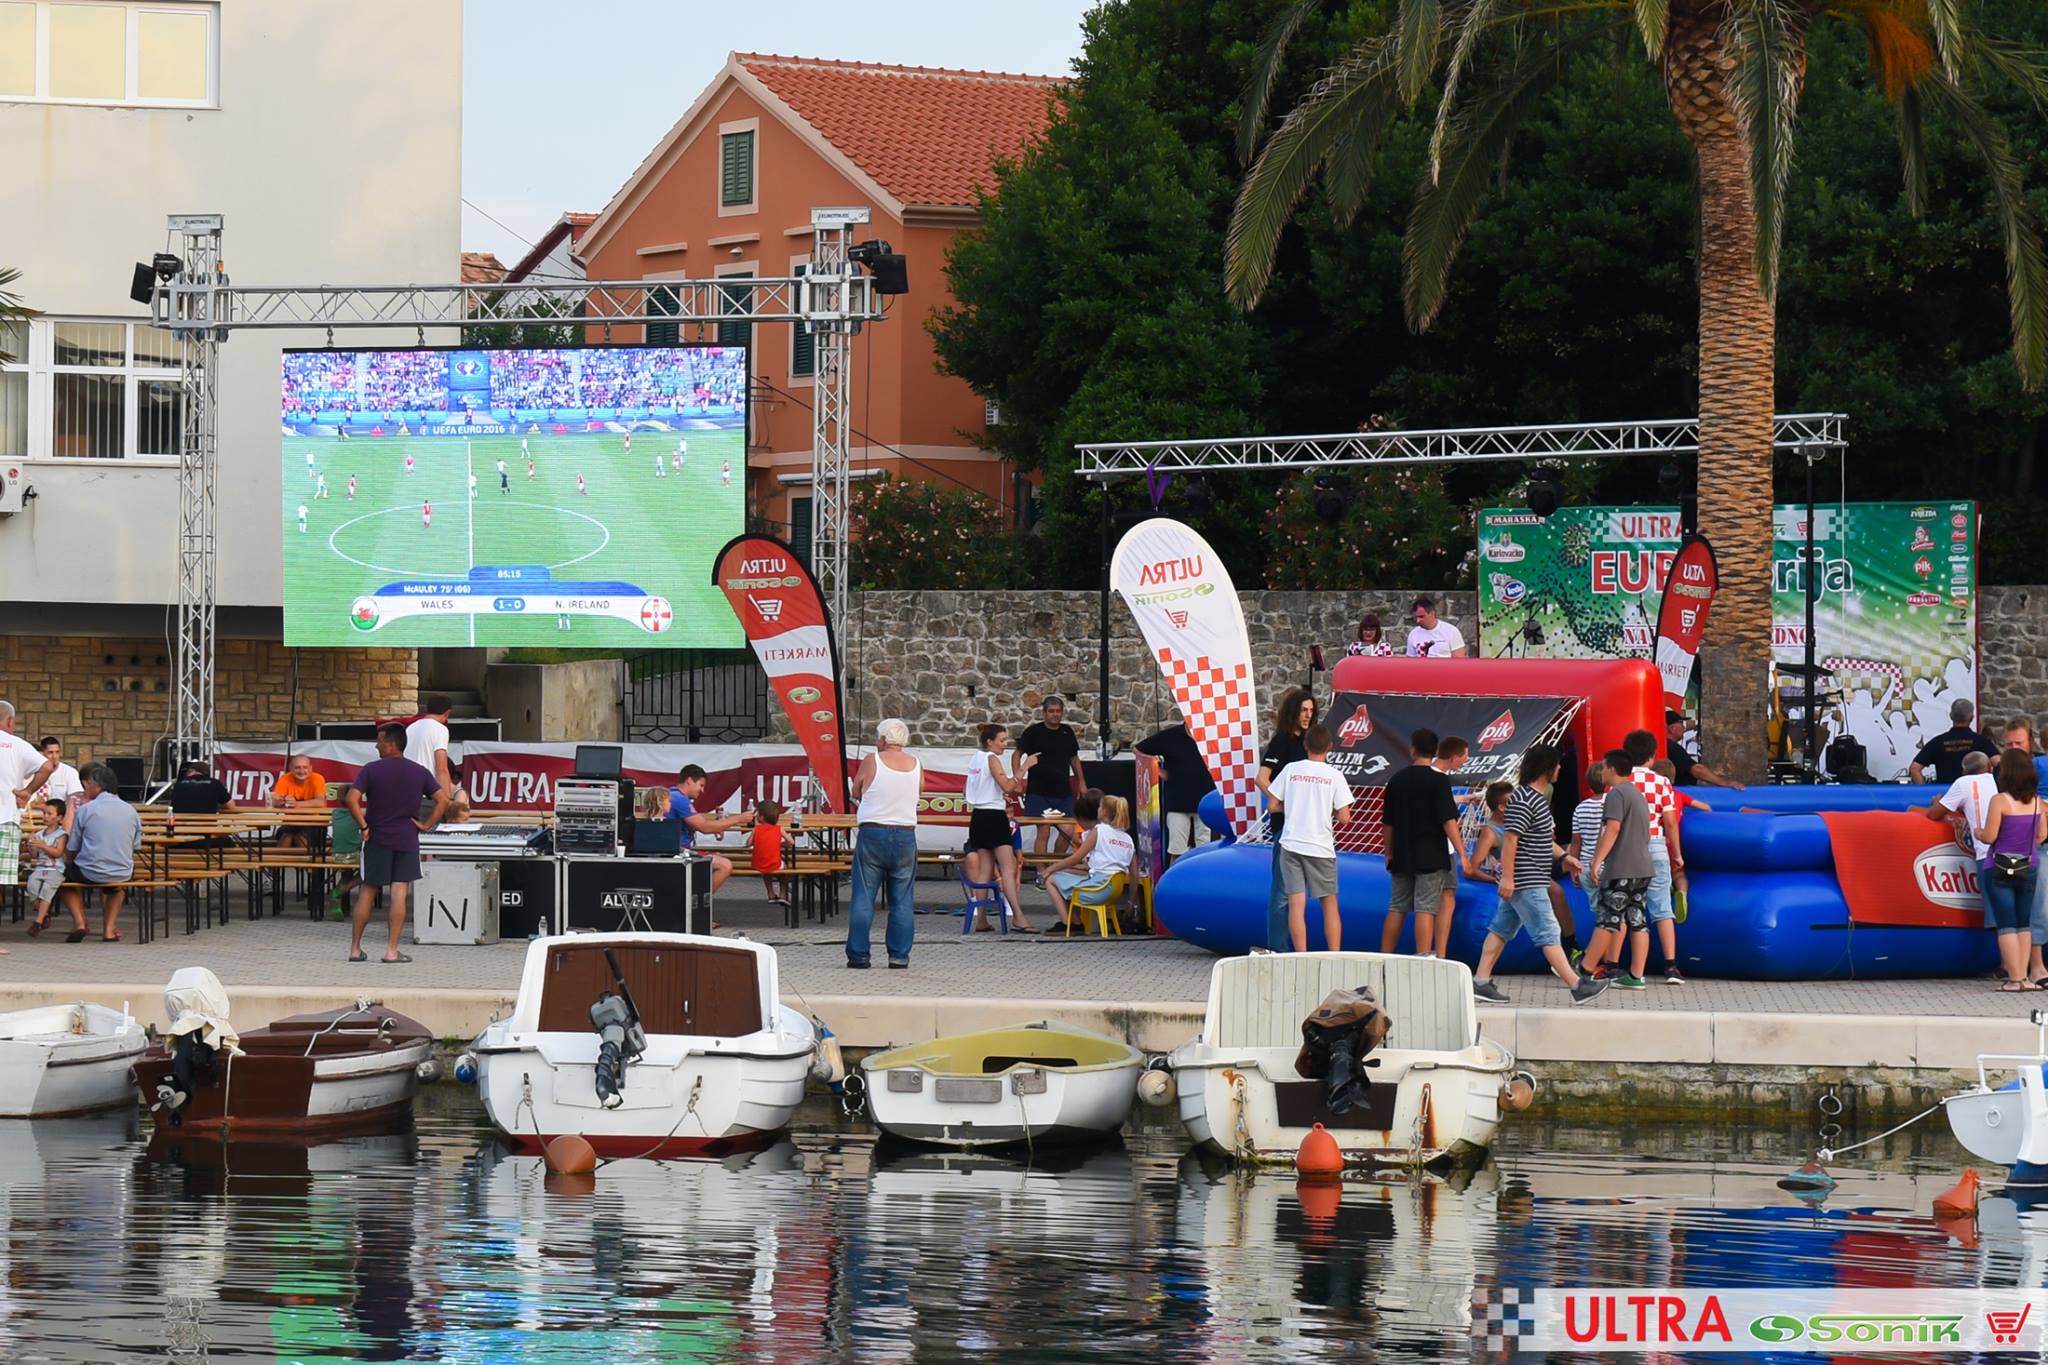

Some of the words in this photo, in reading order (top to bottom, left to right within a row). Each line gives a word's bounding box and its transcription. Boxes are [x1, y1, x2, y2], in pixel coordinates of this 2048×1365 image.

[433, 425, 457, 435] UEFA
[458, 425, 482, 435] EURO
[483, 425, 505, 434] 2016
[1621, 516, 1683, 538] ULTR
[421, 600, 454, 609] WALES
[555, 600, 564, 609] N.
[568, 600, 610, 609] IRELAND
[1339, 715, 1370, 738] pik
[1478, 721, 1513, 744] pik
[214, 770, 278, 800] ULTR
[470, 770, 552, 803] ULTRA
